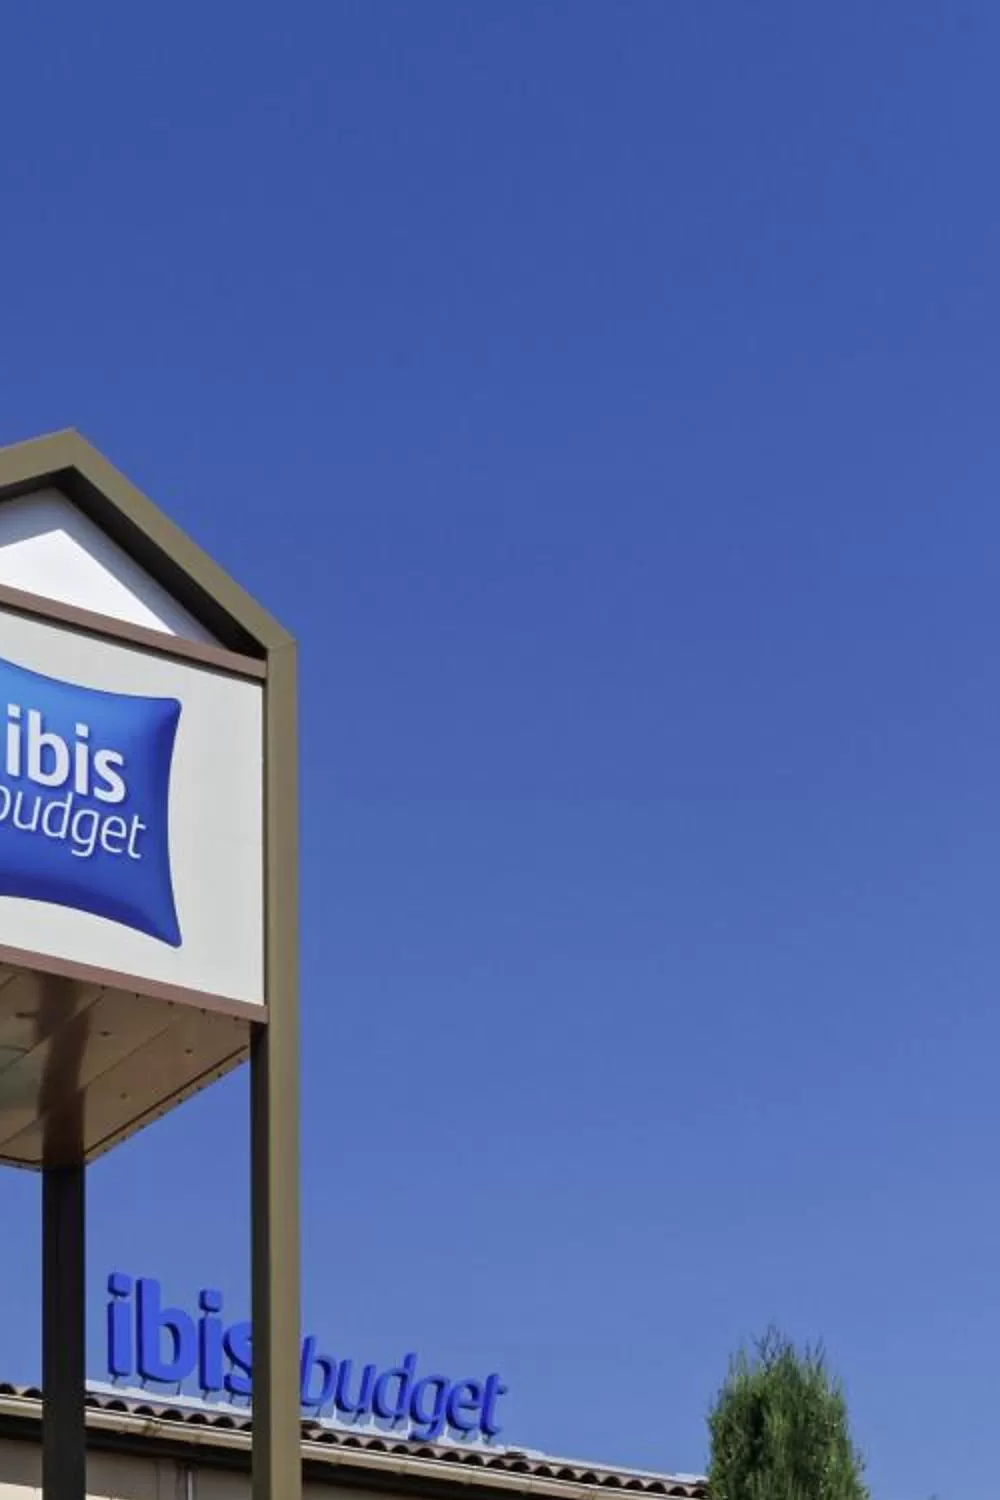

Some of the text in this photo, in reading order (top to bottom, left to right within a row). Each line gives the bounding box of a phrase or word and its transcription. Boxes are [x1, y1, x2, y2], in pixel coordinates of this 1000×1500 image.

[5, 703, 126, 804] ibis
[107, 1272, 508, 1441] ibis budget
